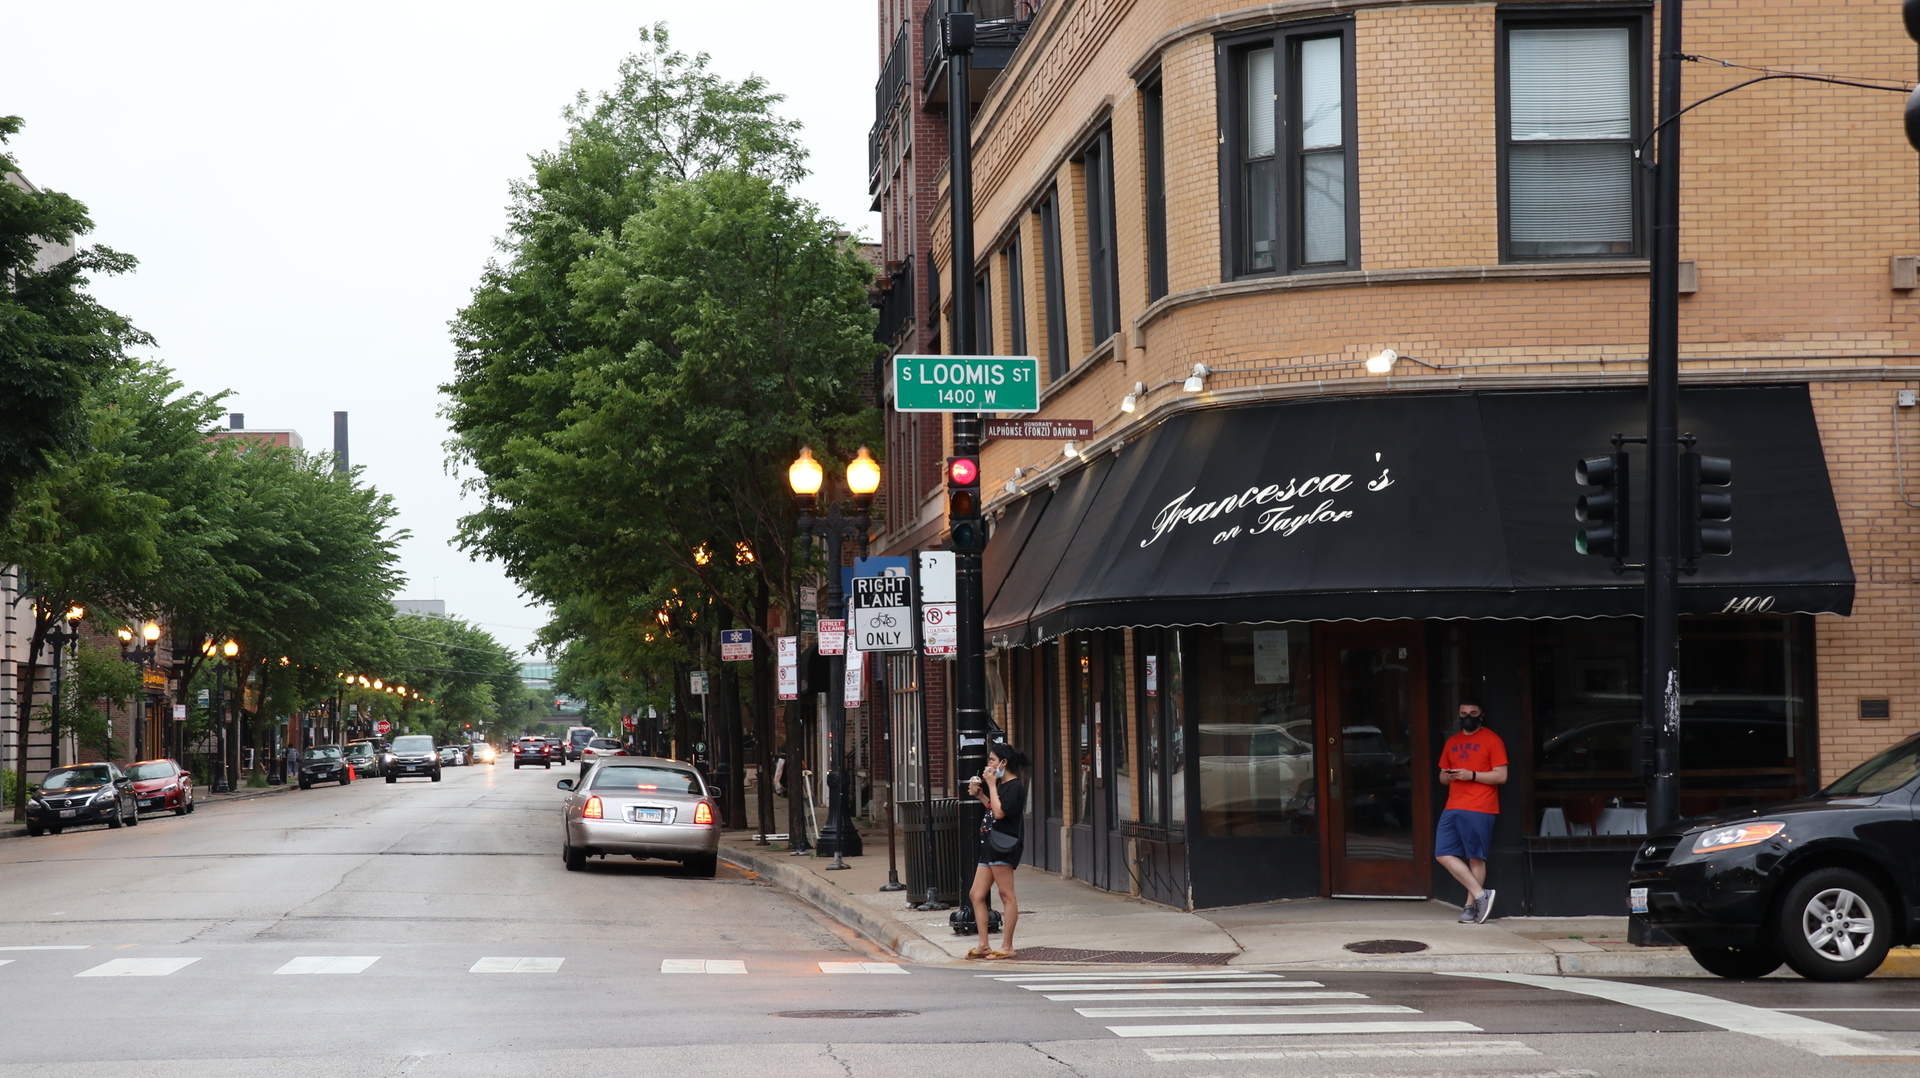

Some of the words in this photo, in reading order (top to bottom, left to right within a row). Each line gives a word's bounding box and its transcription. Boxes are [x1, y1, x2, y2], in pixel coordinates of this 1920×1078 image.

[903, 366, 912, 381] S
[920, 363, 1005, 385] LOOMIS
[1012, 367, 1031, 382] ST
[938, 389, 975, 404] 1400
[984, 389, 996, 404] W
[988, 426, 1022, 436] ALPHONSE
[1024, 426, 1050, 437] (FONZI)
[1053, 427, 1077, 437] DAVINO
[1212, 524, 1242, 545] on
[1250, 498, 1354, 537] Taylor
[858, 577, 905, 593] RIGHT
[861, 592, 904, 608] LANE
[1721, 595, 1776, 613] 1400
[866, 631, 901, 646] ONLY
